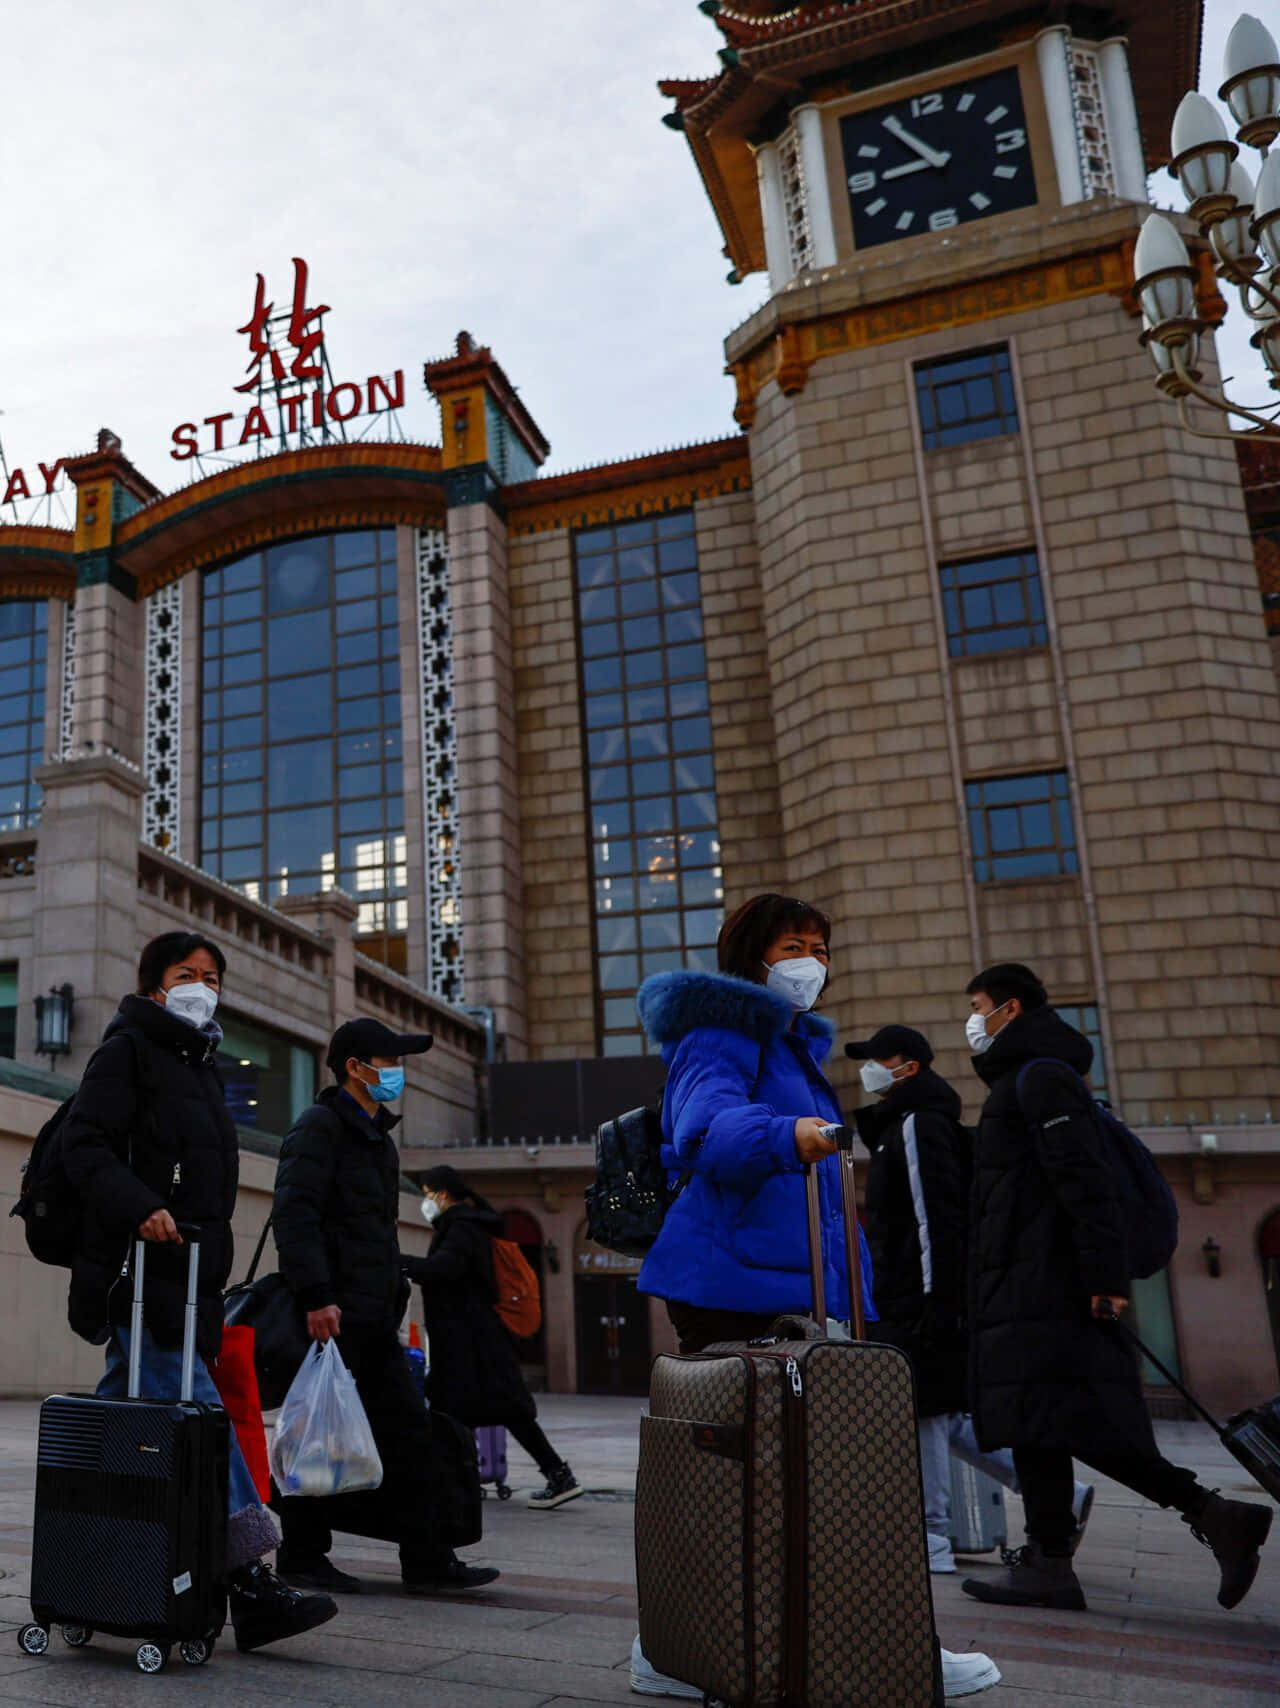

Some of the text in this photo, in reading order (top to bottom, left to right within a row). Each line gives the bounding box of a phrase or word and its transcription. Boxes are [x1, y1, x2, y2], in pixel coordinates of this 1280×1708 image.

[911, 93, 944, 118] 12
[994, 128, 1026, 154] 3
[847, 171, 876, 194] 9
[928, 208, 958, 232] 6
[232, 257, 332, 392] 站
[169, 369, 404, 460] STATION
